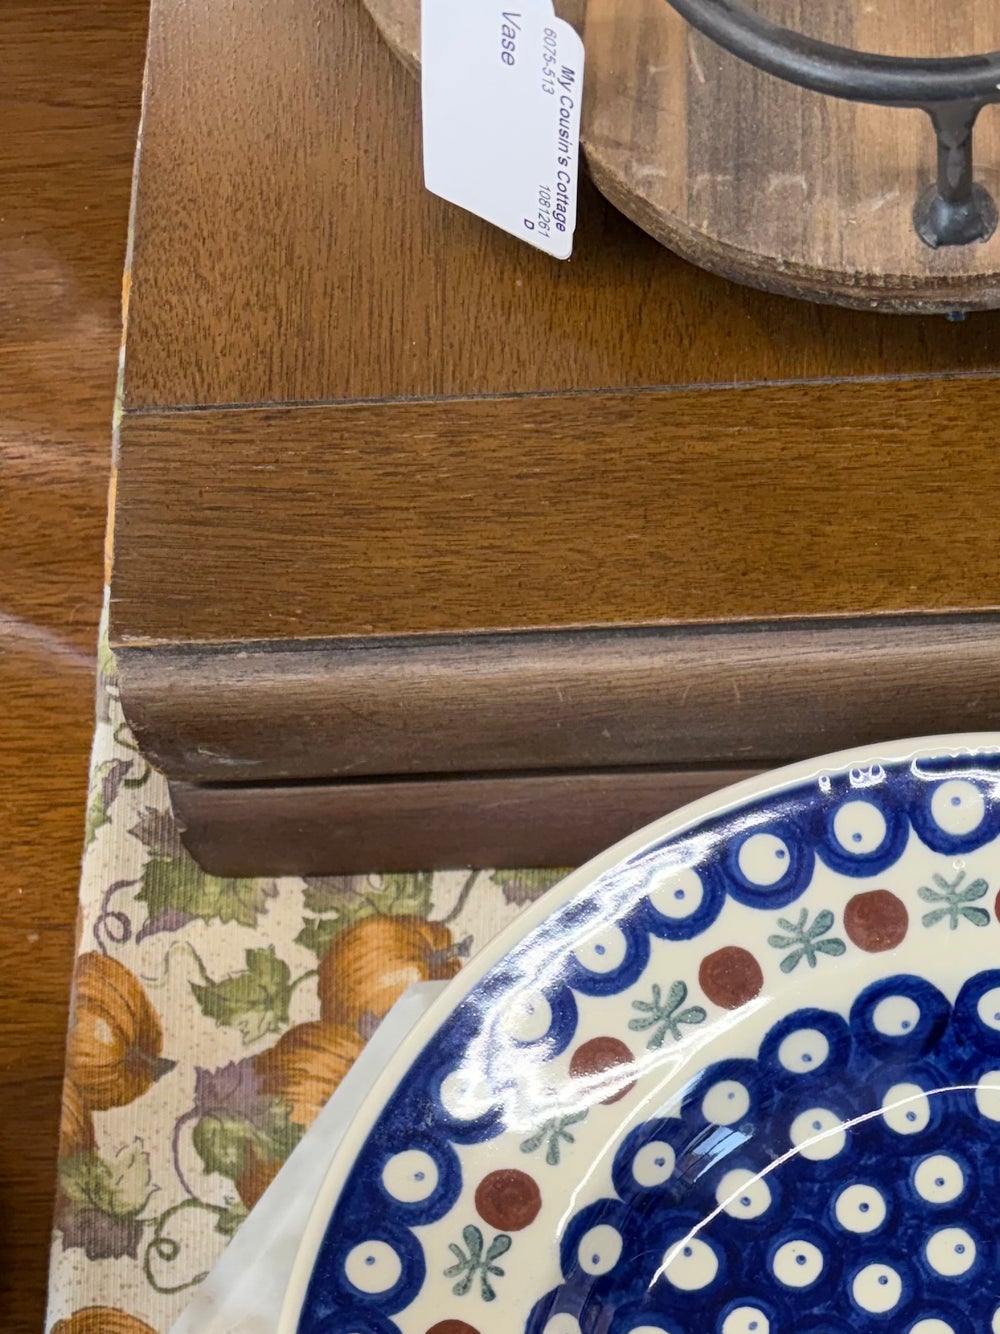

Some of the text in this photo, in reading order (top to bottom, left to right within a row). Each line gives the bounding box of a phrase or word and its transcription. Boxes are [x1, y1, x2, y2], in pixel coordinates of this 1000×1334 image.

[501, 11, 521, 66] Vase
[541, 28, 557, 95] 6075-513
[553, 66, 575, 232] My Cousin's Cottage
[524, 219, 535, 230] D
[537, 184, 550, 238] 1081261
